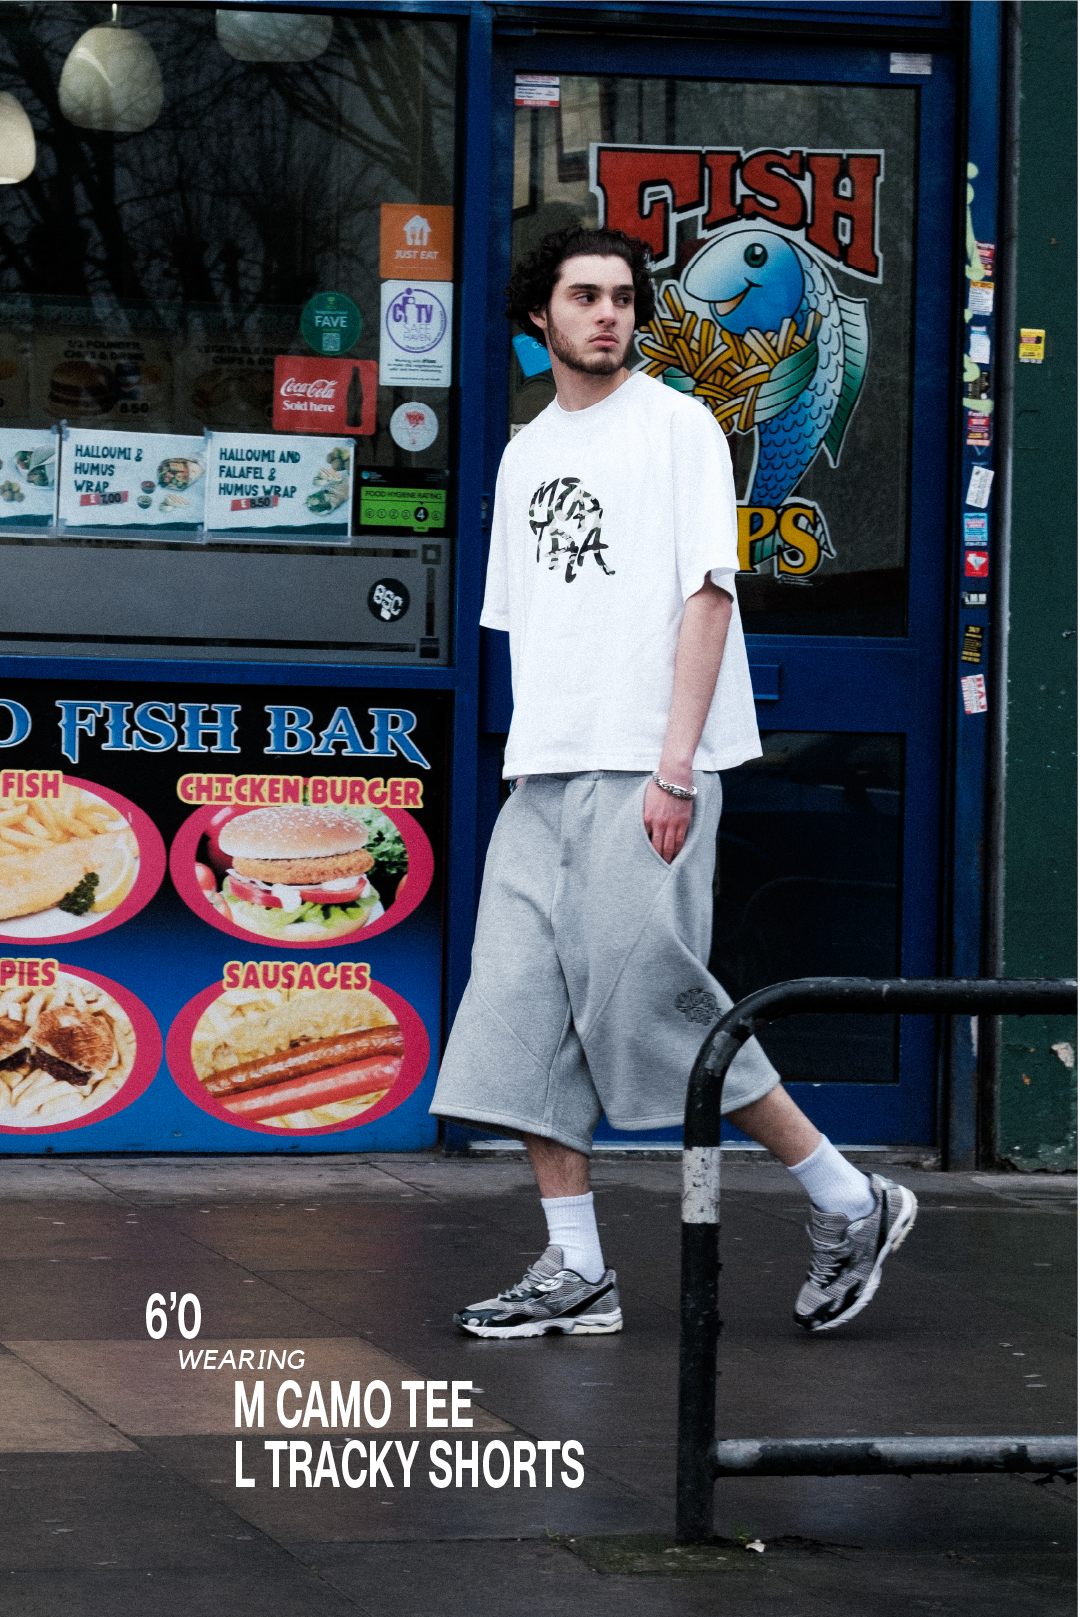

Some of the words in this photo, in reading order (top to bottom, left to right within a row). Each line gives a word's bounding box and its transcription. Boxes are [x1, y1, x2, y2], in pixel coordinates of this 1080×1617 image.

[597, 147, 883, 278] FISH
[395, 250, 418, 259] JUST
[420, 251, 439, 260] EAT
[315, 316, 348, 328] FAVE
[280, 378, 338, 399] Coca-Cola
[282, 400, 307, 411] Sold
[309, 401, 335, 412] here
[75, 444, 131, 460] HALLOUMI
[134, 448, 143, 462] &
[219, 448, 276, 462] HALLOUMI
[278, 450, 301, 463] AND
[74, 462, 115, 476] HUMUS
[219, 465, 264, 479] FALAFEL
[267, 467, 276, 481] &
[74, 480, 109, 493] WRAP
[219, 483, 259, 496] HUMUS
[262, 485, 297, 498] WRAP
[250, 498, 270, 508] 8.50
[416, 508, 425, 520] 4
[56, 700, 241, 764] FISH
[264, 705, 431, 769] BAR
[2, 772, 60, 799] FISH
[179, 776, 303, 803] CHICKEN
[312, 778, 423, 806] BURGER
[0, 960, 56, 987] PIES
[224, 963, 370, 990] SAUSAGES
